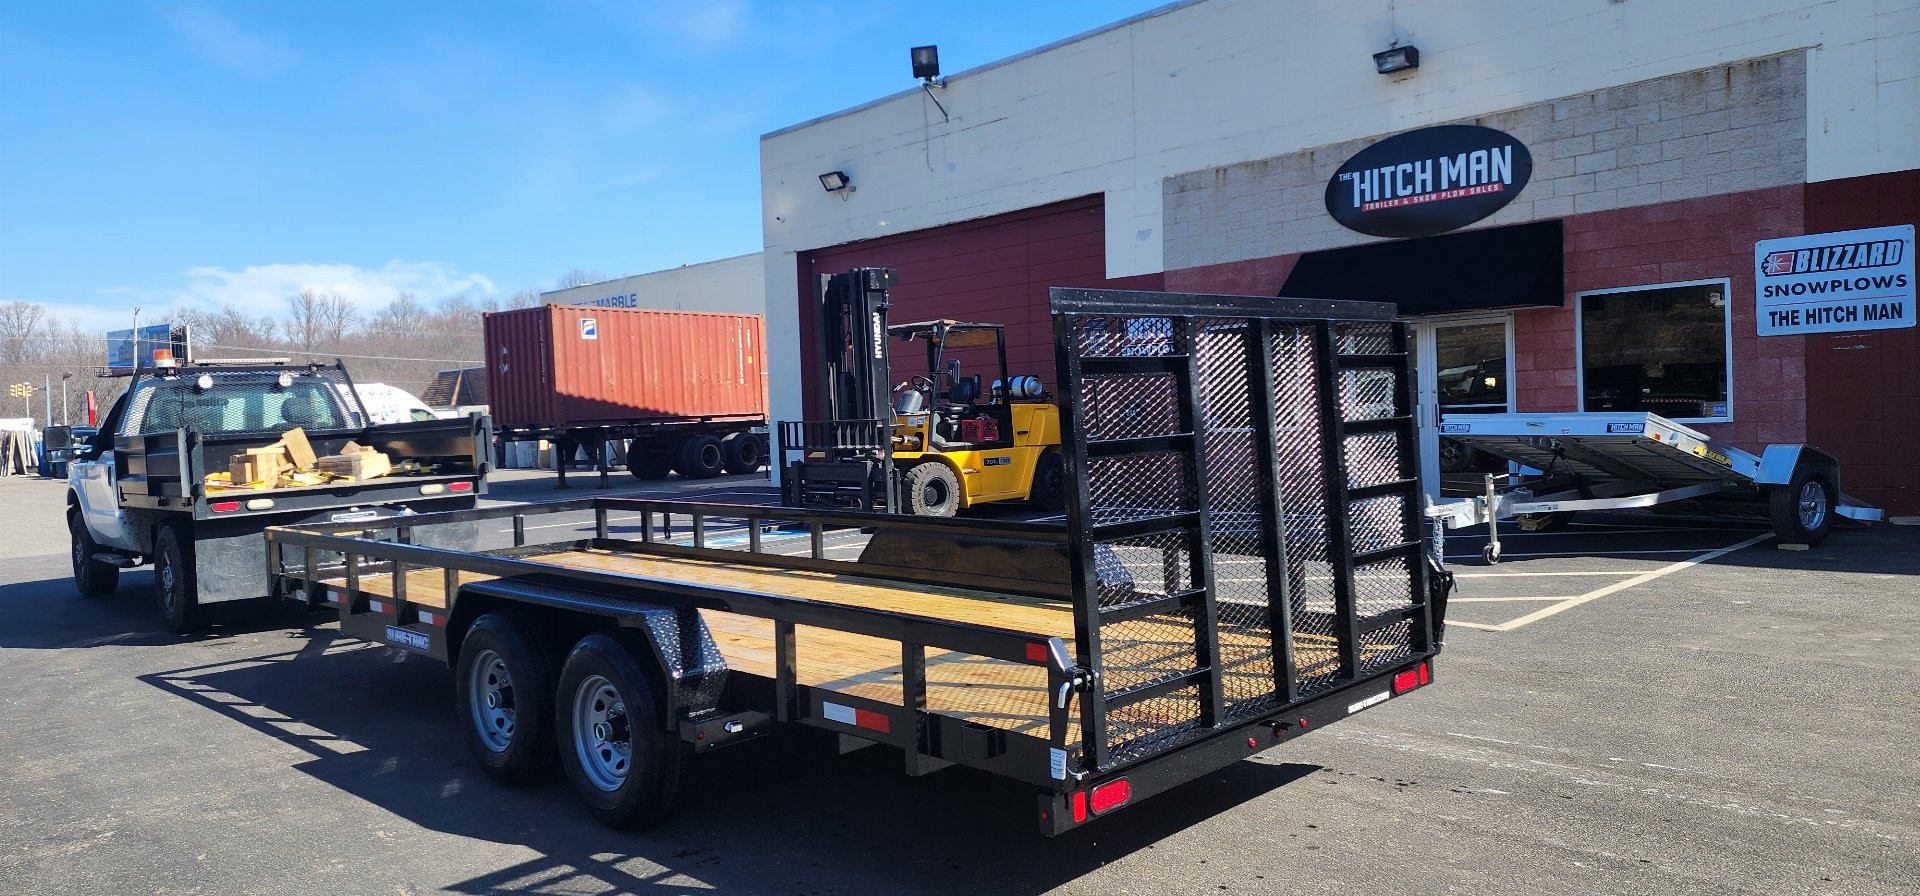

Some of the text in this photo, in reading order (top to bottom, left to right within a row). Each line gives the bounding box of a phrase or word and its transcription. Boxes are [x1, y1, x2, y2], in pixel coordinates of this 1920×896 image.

[1339, 145, 1512, 208] THE HITCH MAN
[1365, 199, 1399, 211] TRAILER
[1413, 193, 1437, 204] SNOW
[1441, 189, 1466, 199] PLOW
[1470, 184, 1499, 195] SALES
[1795, 241, 1902, 273] BLIZZARD
[1763, 274, 1908, 298] SNOWPLOWS
[1768, 302, 1903, 327] THE HITCH MAN
[872, 312, 882, 358] HYUNDAI
[1609, 423, 1644, 432] HITCH MAN
